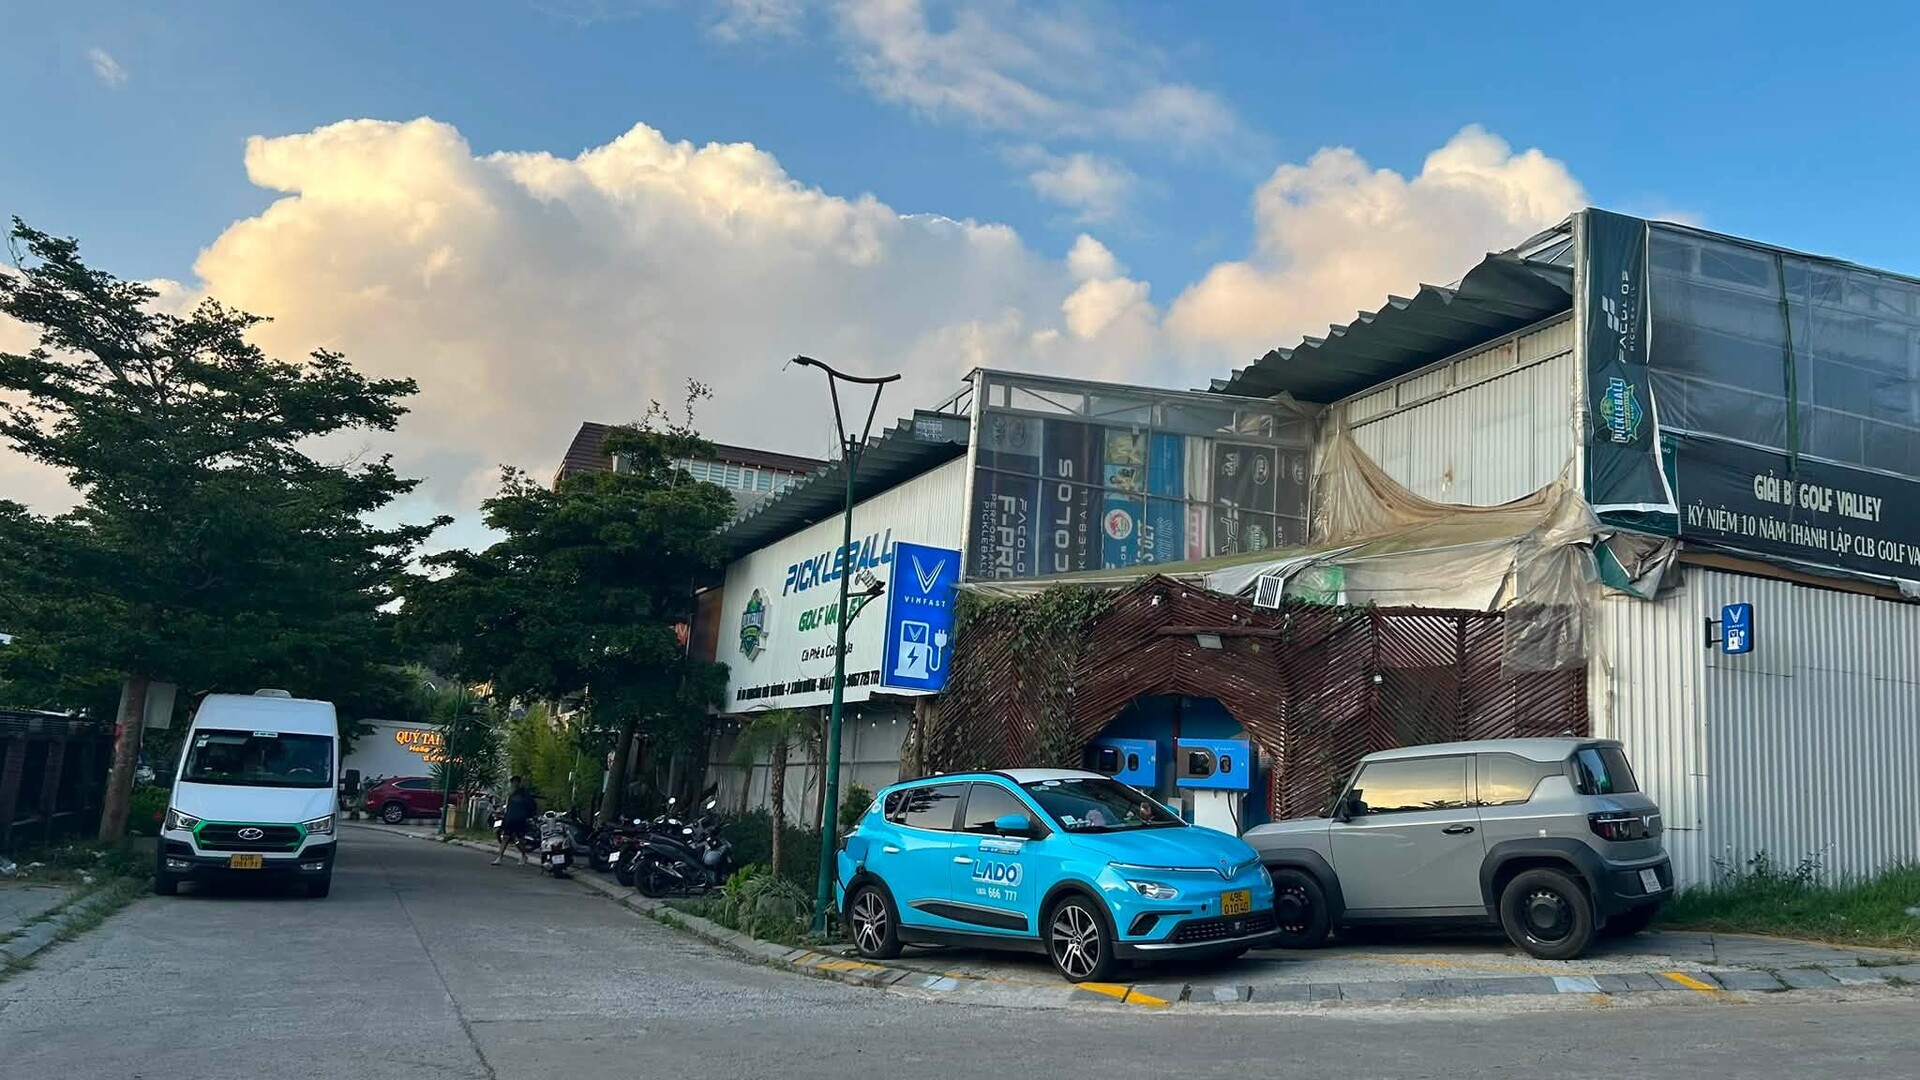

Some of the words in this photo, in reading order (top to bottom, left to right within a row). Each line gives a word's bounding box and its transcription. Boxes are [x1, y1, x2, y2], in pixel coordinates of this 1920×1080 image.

[1613, 382, 1626, 440] PICKLEBALL
[1055, 458, 1073, 572] COLOS
[1754, 469, 1779, 503] GIẢI
[1800, 484, 1832, 513] GOLF
[1836, 490, 1882, 522] VALLEY
[1688, 499, 1705, 527] KỶ
[1707, 504, 1738, 536] NIỆM
[1741, 514, 1756, 536] 10
[1759, 514, 1787, 542] NĂM
[1790, 520, 1827, 550] THÀNH
[1830, 526, 1851, 557] LẬP
[1854, 535, 1875, 558] CLB
[1878, 540, 1905, 563] GOLF
[783, 528, 892, 597] PICKLEBALL
[798, 606, 825, 632] GOLF
[824, 595, 865, 626] VAEY
[904, 595, 946, 608] VINFAST
[395, 729, 420, 745] QUÝ
[972, 859, 1019, 884] LADO
[988, 887, 1001, 899] 666
[1005, 889, 1018, 901] 777
